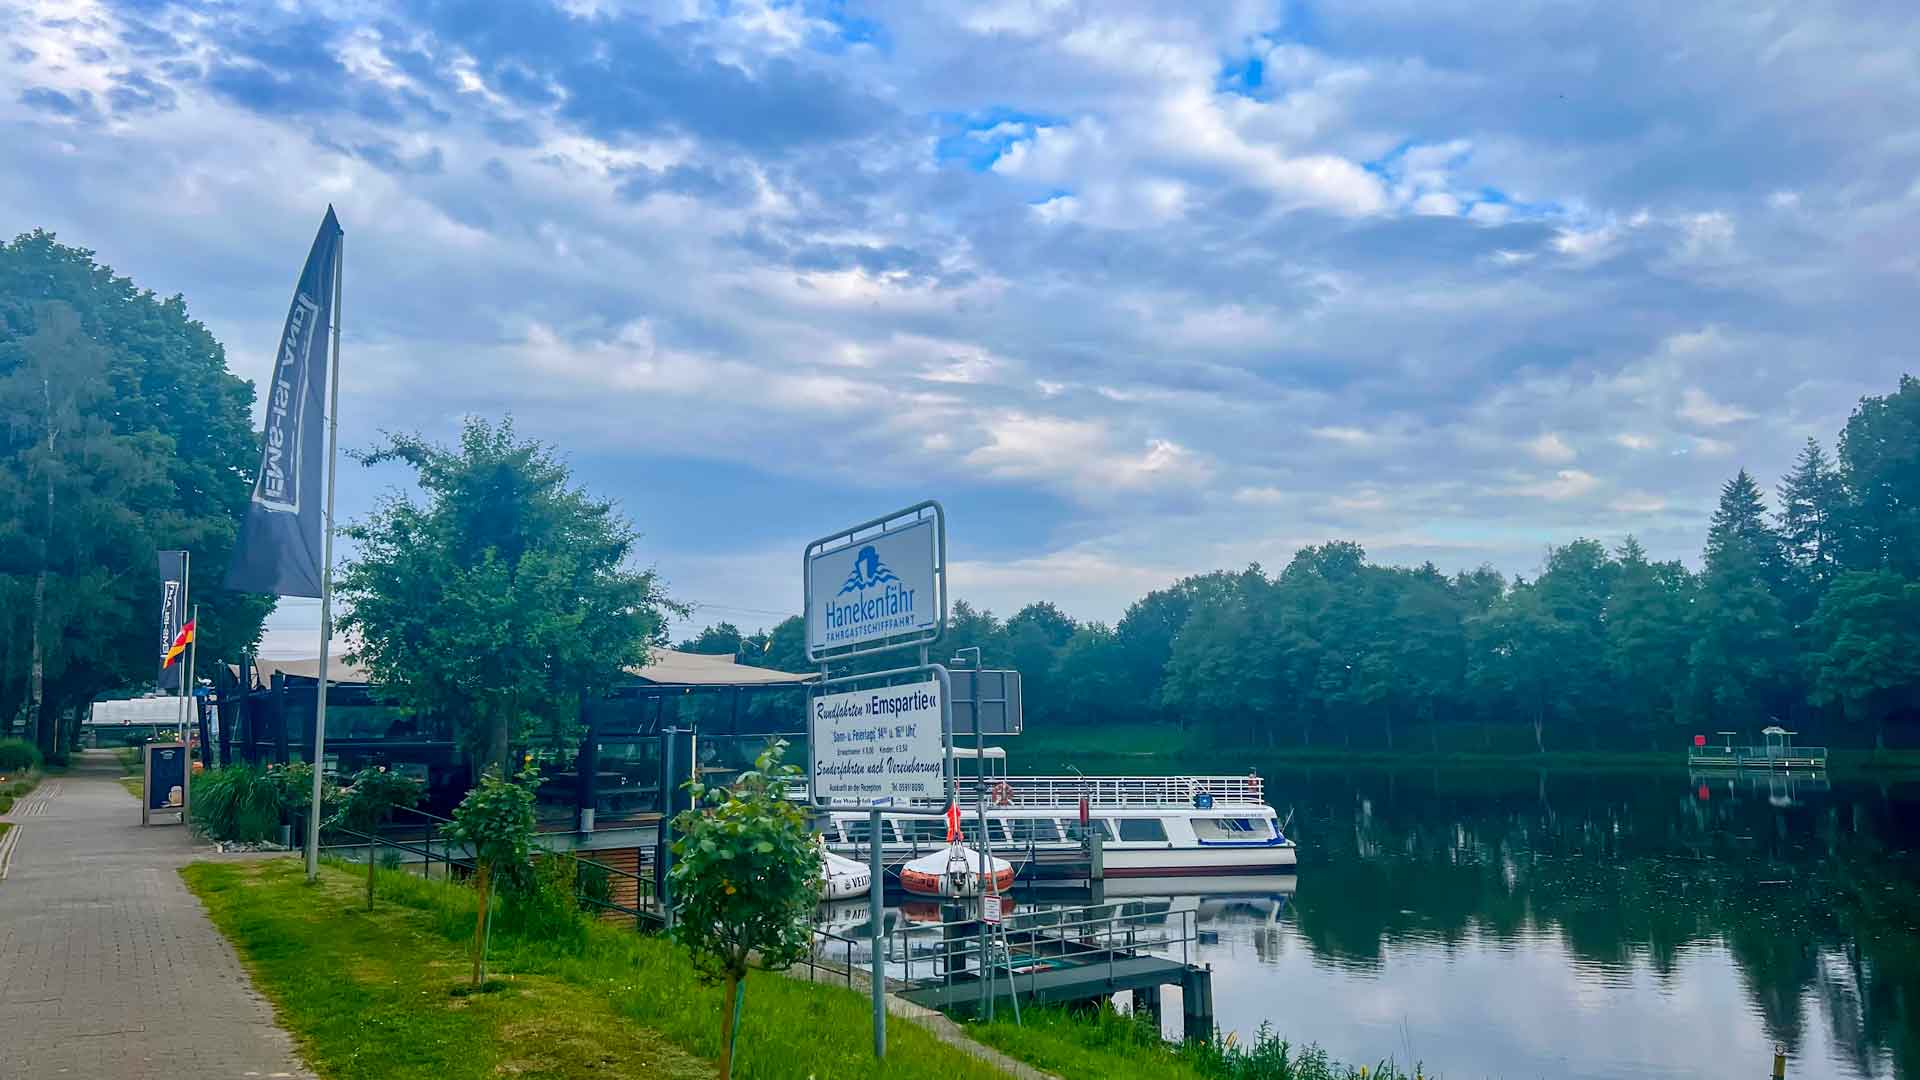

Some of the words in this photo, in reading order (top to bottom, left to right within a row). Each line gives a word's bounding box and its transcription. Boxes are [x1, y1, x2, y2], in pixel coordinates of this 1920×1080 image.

[826, 583, 915, 629] Hanekenfähr
[816, 699, 863, 724] Rundfahrten
[816, 759, 865, 780] Sonderfahrten
[866, 759, 884, 775] nach
[886, 755, 941, 778] Vereinbarung
